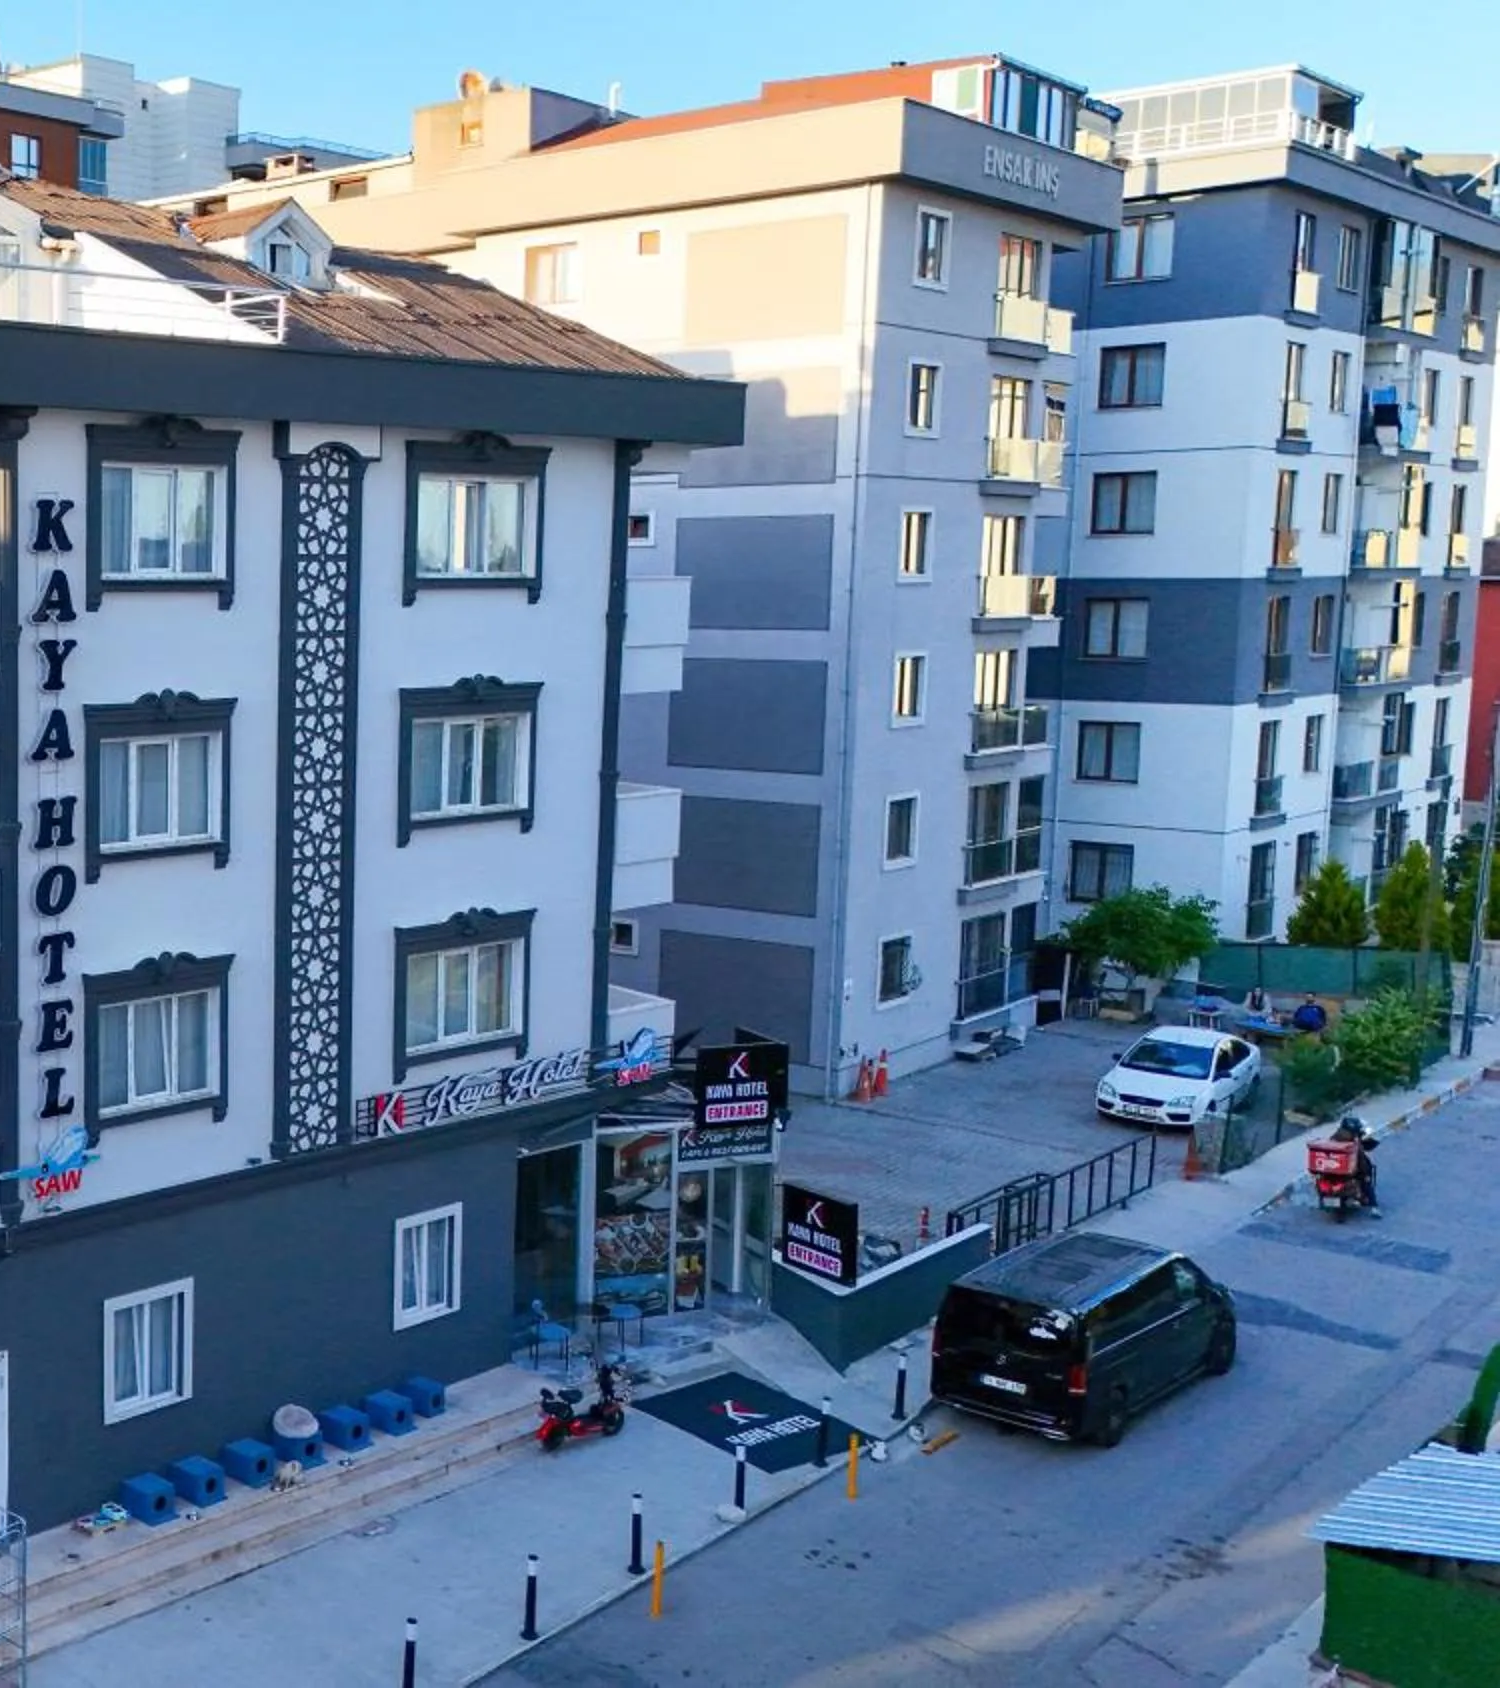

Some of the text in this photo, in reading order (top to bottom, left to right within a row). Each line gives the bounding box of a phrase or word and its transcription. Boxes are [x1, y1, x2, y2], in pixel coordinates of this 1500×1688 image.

[984, 145, 1031, 188] ENSAR
[30, 497, 78, 1119] KAYA HOTEL
[424, 1050, 585, 1127] Kaya Hotel
[736, 1080, 768, 1097] HOTEL
[708, 1102, 765, 1121] ENTRANCE
[35, 1168, 82, 1199] SAW
[814, 1230, 842, 1255] HOTEL
[788, 1244, 840, 1275] ENTRANCE
[765, 1414, 821, 1438] HOTEL
